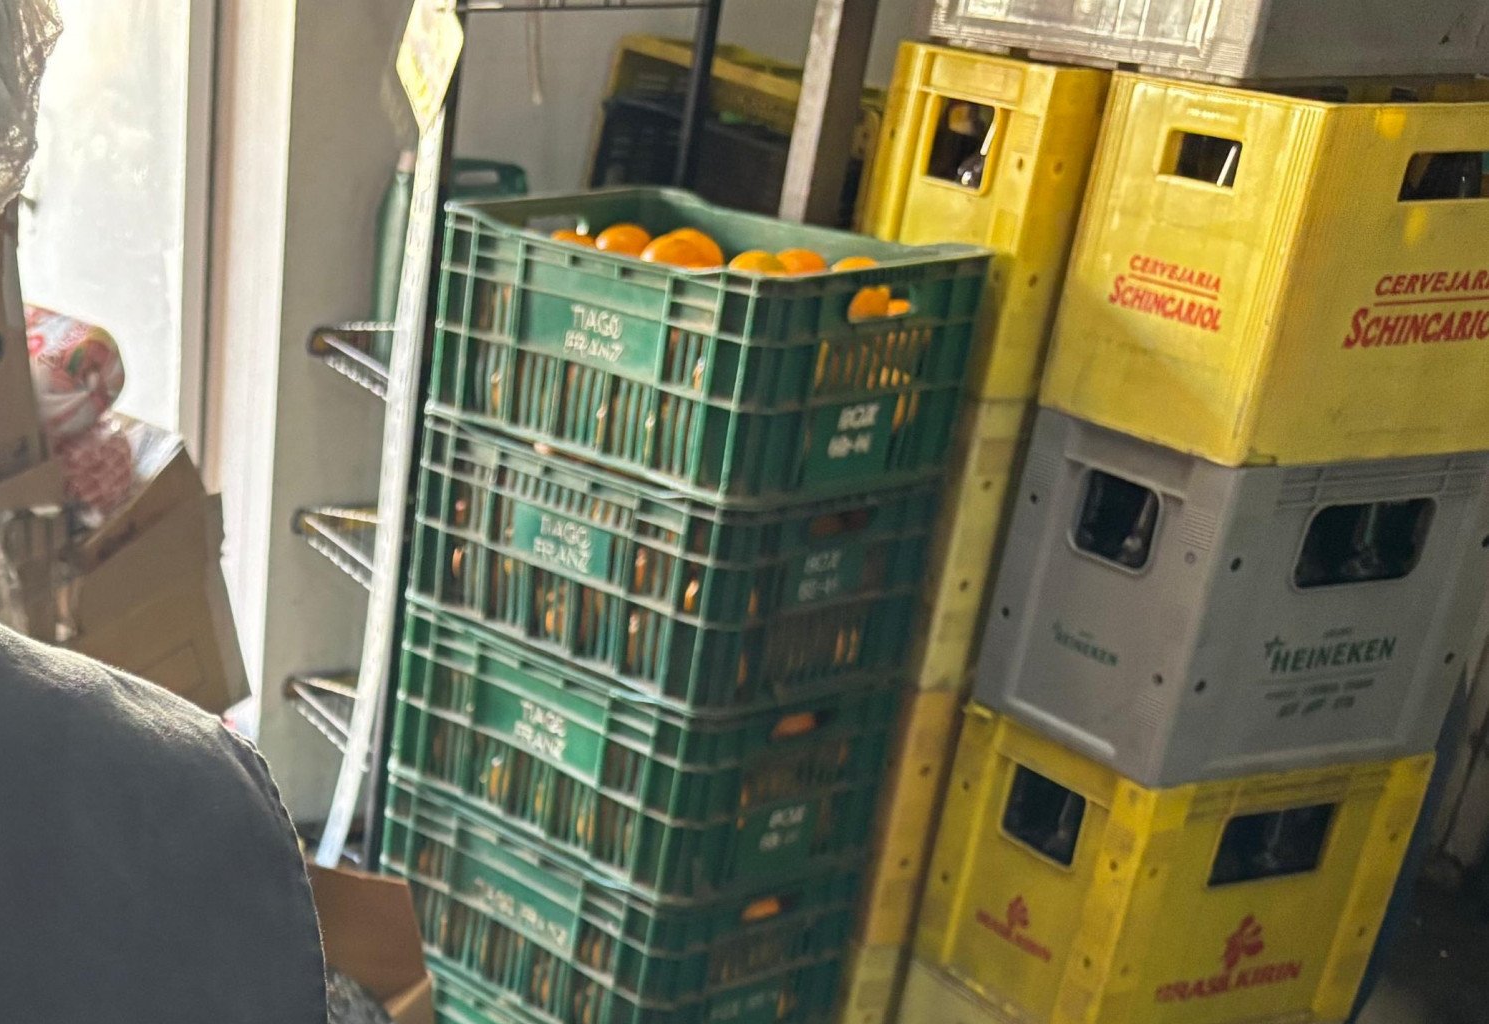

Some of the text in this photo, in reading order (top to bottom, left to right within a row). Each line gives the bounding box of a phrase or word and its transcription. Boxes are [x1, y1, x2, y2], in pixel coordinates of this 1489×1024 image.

[1129, 253, 1220, 293] CERVEJARIA
[1108, 275, 1222, 333] SCHINCARIOL
[1270, 636, 1397, 673] HEINEKEN
